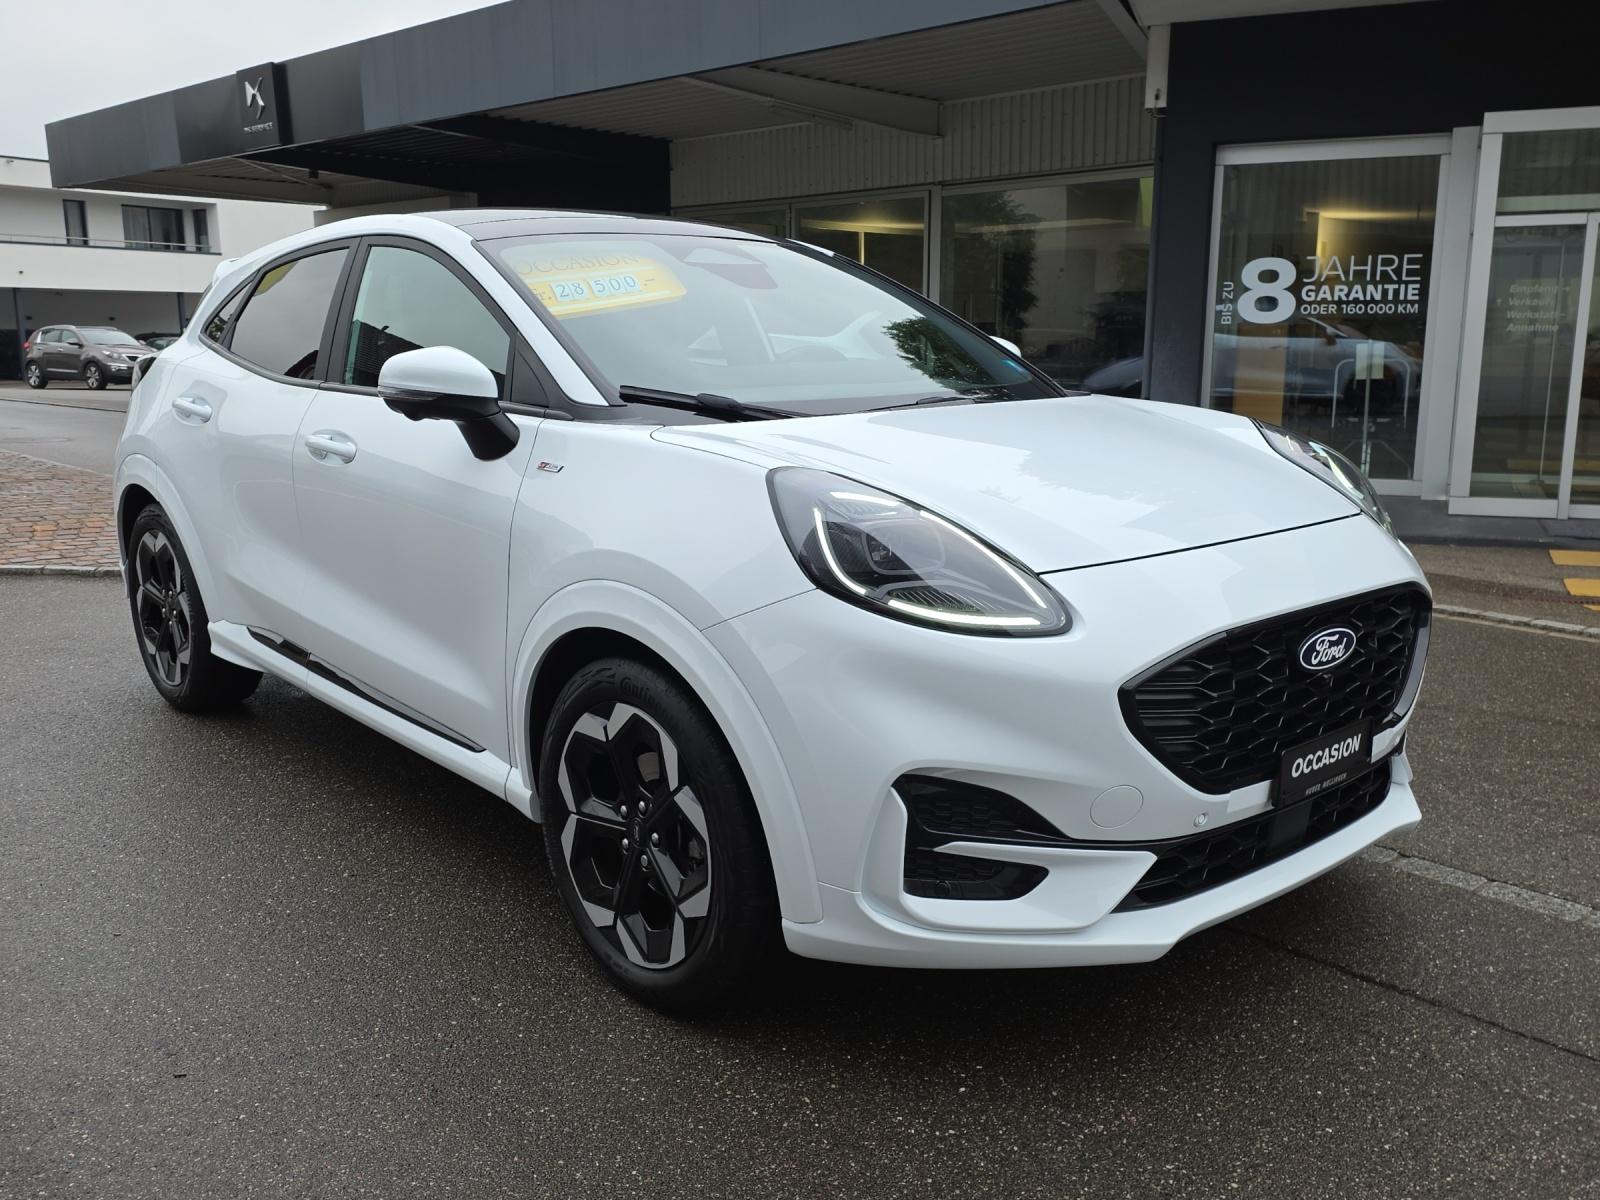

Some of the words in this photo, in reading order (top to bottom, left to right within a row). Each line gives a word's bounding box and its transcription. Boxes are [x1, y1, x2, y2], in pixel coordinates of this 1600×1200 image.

[515, 254, 640, 275] OCCASION
[1302, 253, 1423, 282] JAHRE
[555, 281, 585, 298] 28
[593, 275, 636, 293] 500
[1222, 281, 1234, 299] ZU
[1237, 256, 1297, 324] 8
[1301, 283, 1420, 301] GARANTIE
[1221, 303, 1233, 324] BIS
[1300, 303, 1337, 315] ODER
[1341, 303, 1365, 314] 160
[1367, 303, 1395, 314] 000
[1397, 303, 1419, 314] KM
[1311, 633, 1347, 665] Ford
[1291, 733, 1362, 778] OCCASION
